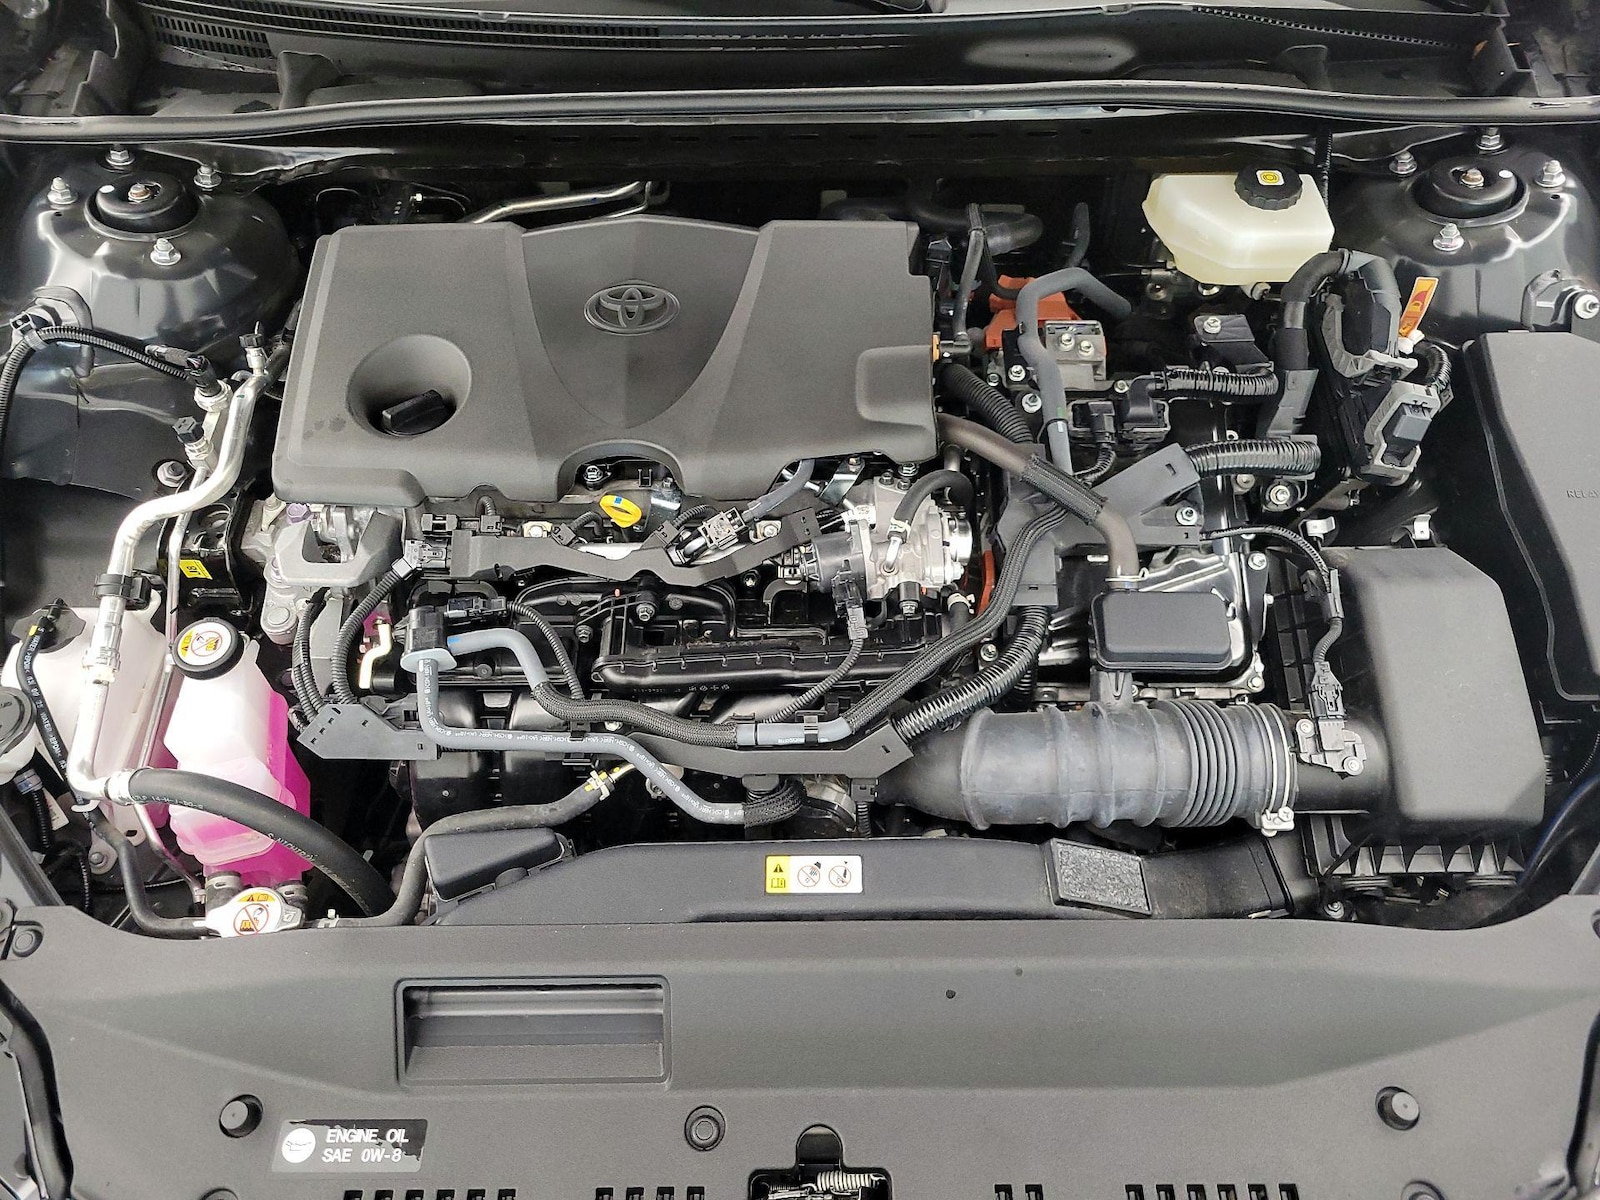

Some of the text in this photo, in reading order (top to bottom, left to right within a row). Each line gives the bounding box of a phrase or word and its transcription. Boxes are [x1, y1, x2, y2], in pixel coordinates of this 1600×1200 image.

[40, 711, 53, 732] WATER
[326, 1128, 409, 1143] ENGINE OIL
[322, 1148, 402, 1162] SAE 0W-8
